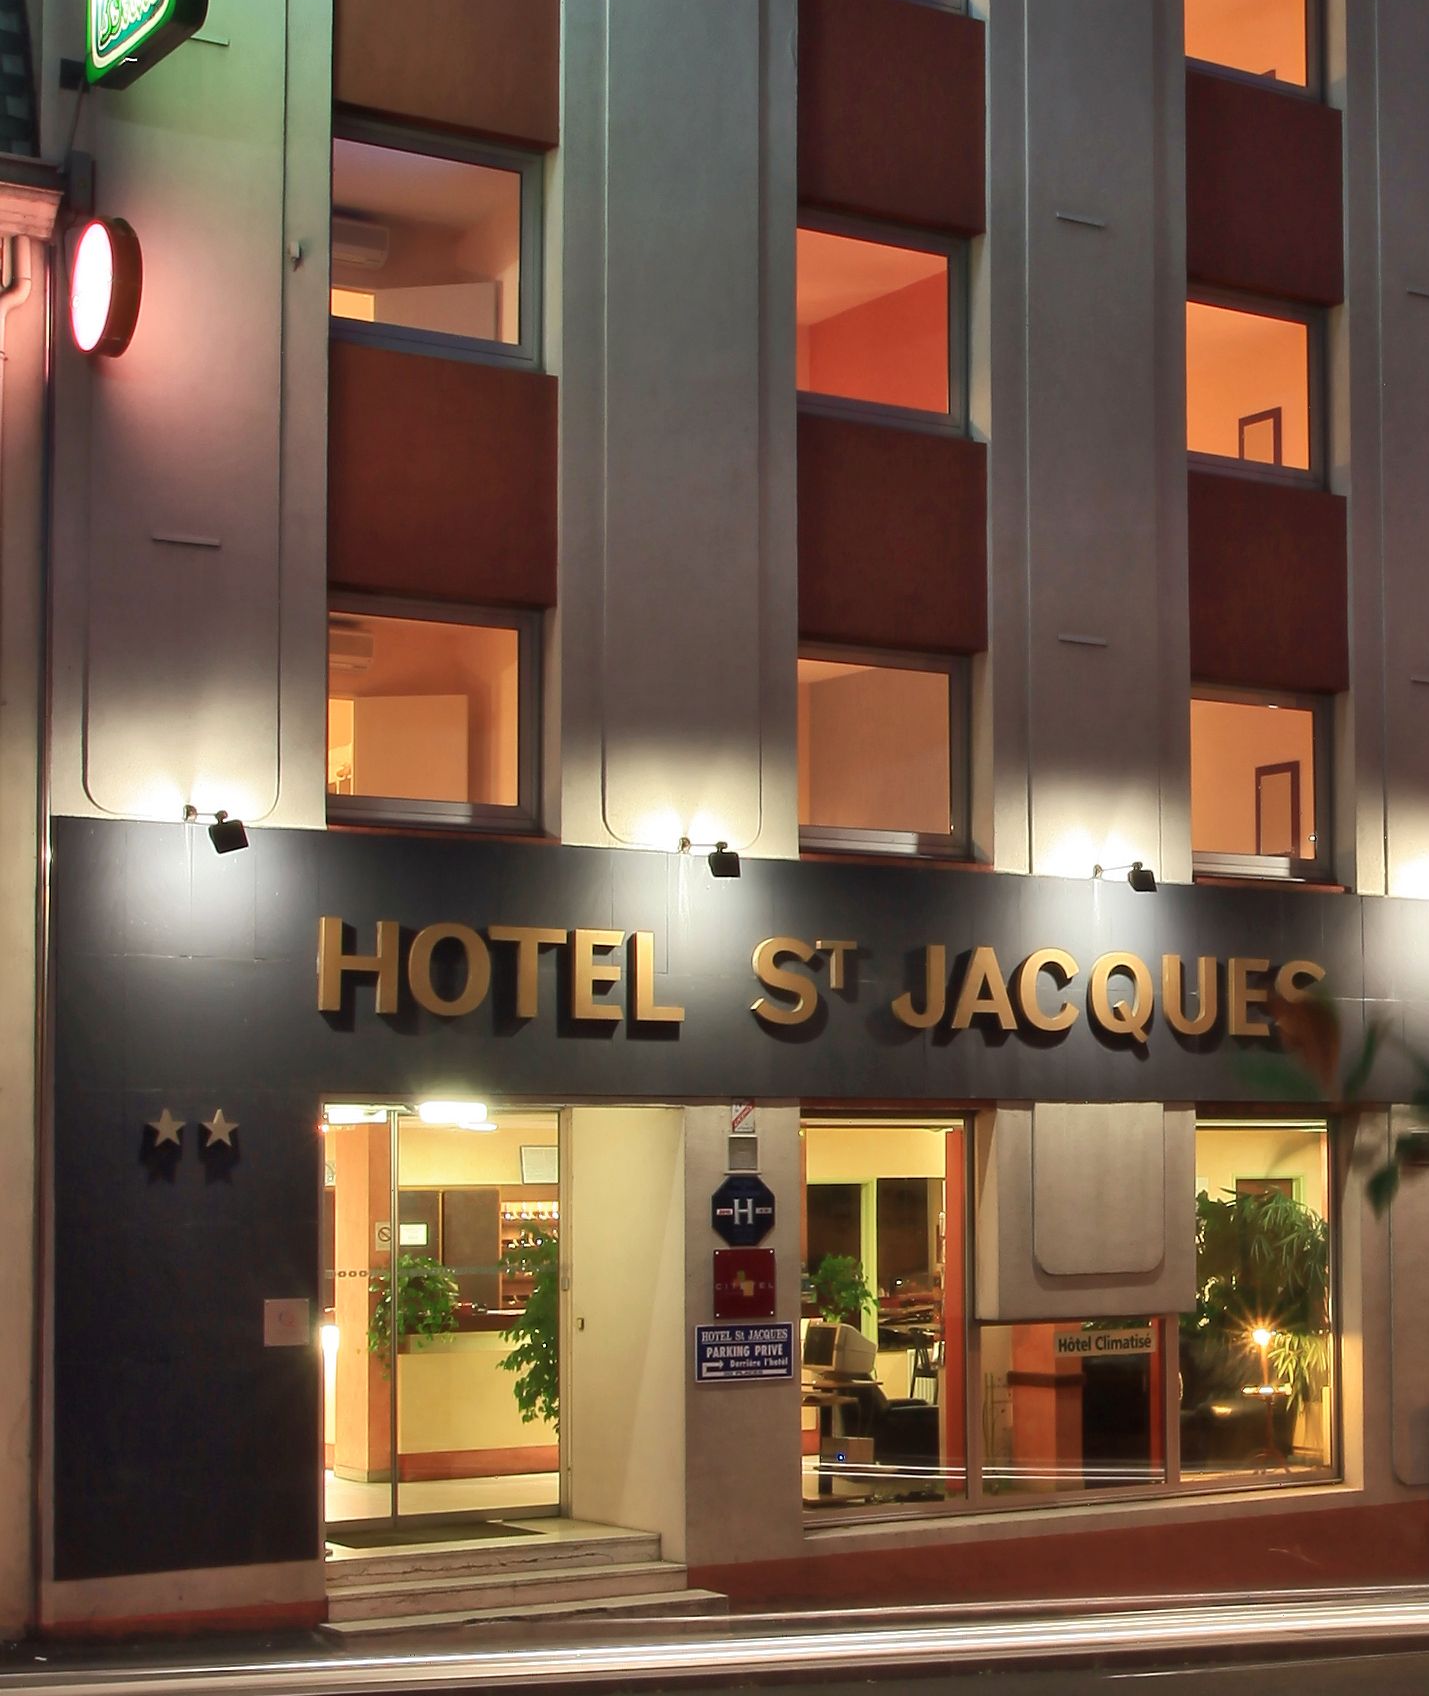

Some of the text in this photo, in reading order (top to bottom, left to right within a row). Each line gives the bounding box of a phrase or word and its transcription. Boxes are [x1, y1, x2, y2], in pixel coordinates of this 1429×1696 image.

[317, 916, 685, 1022] HOTEL
[734, 1198, 753, 1224] H
[702, 1330, 732, 1342] HOTEL
[748, 1328, 788, 1340] JACQUES
[1058, 1333, 1151, 1352] Hôtel Climatisé
[706, 1345, 750, 1358] PARKING
